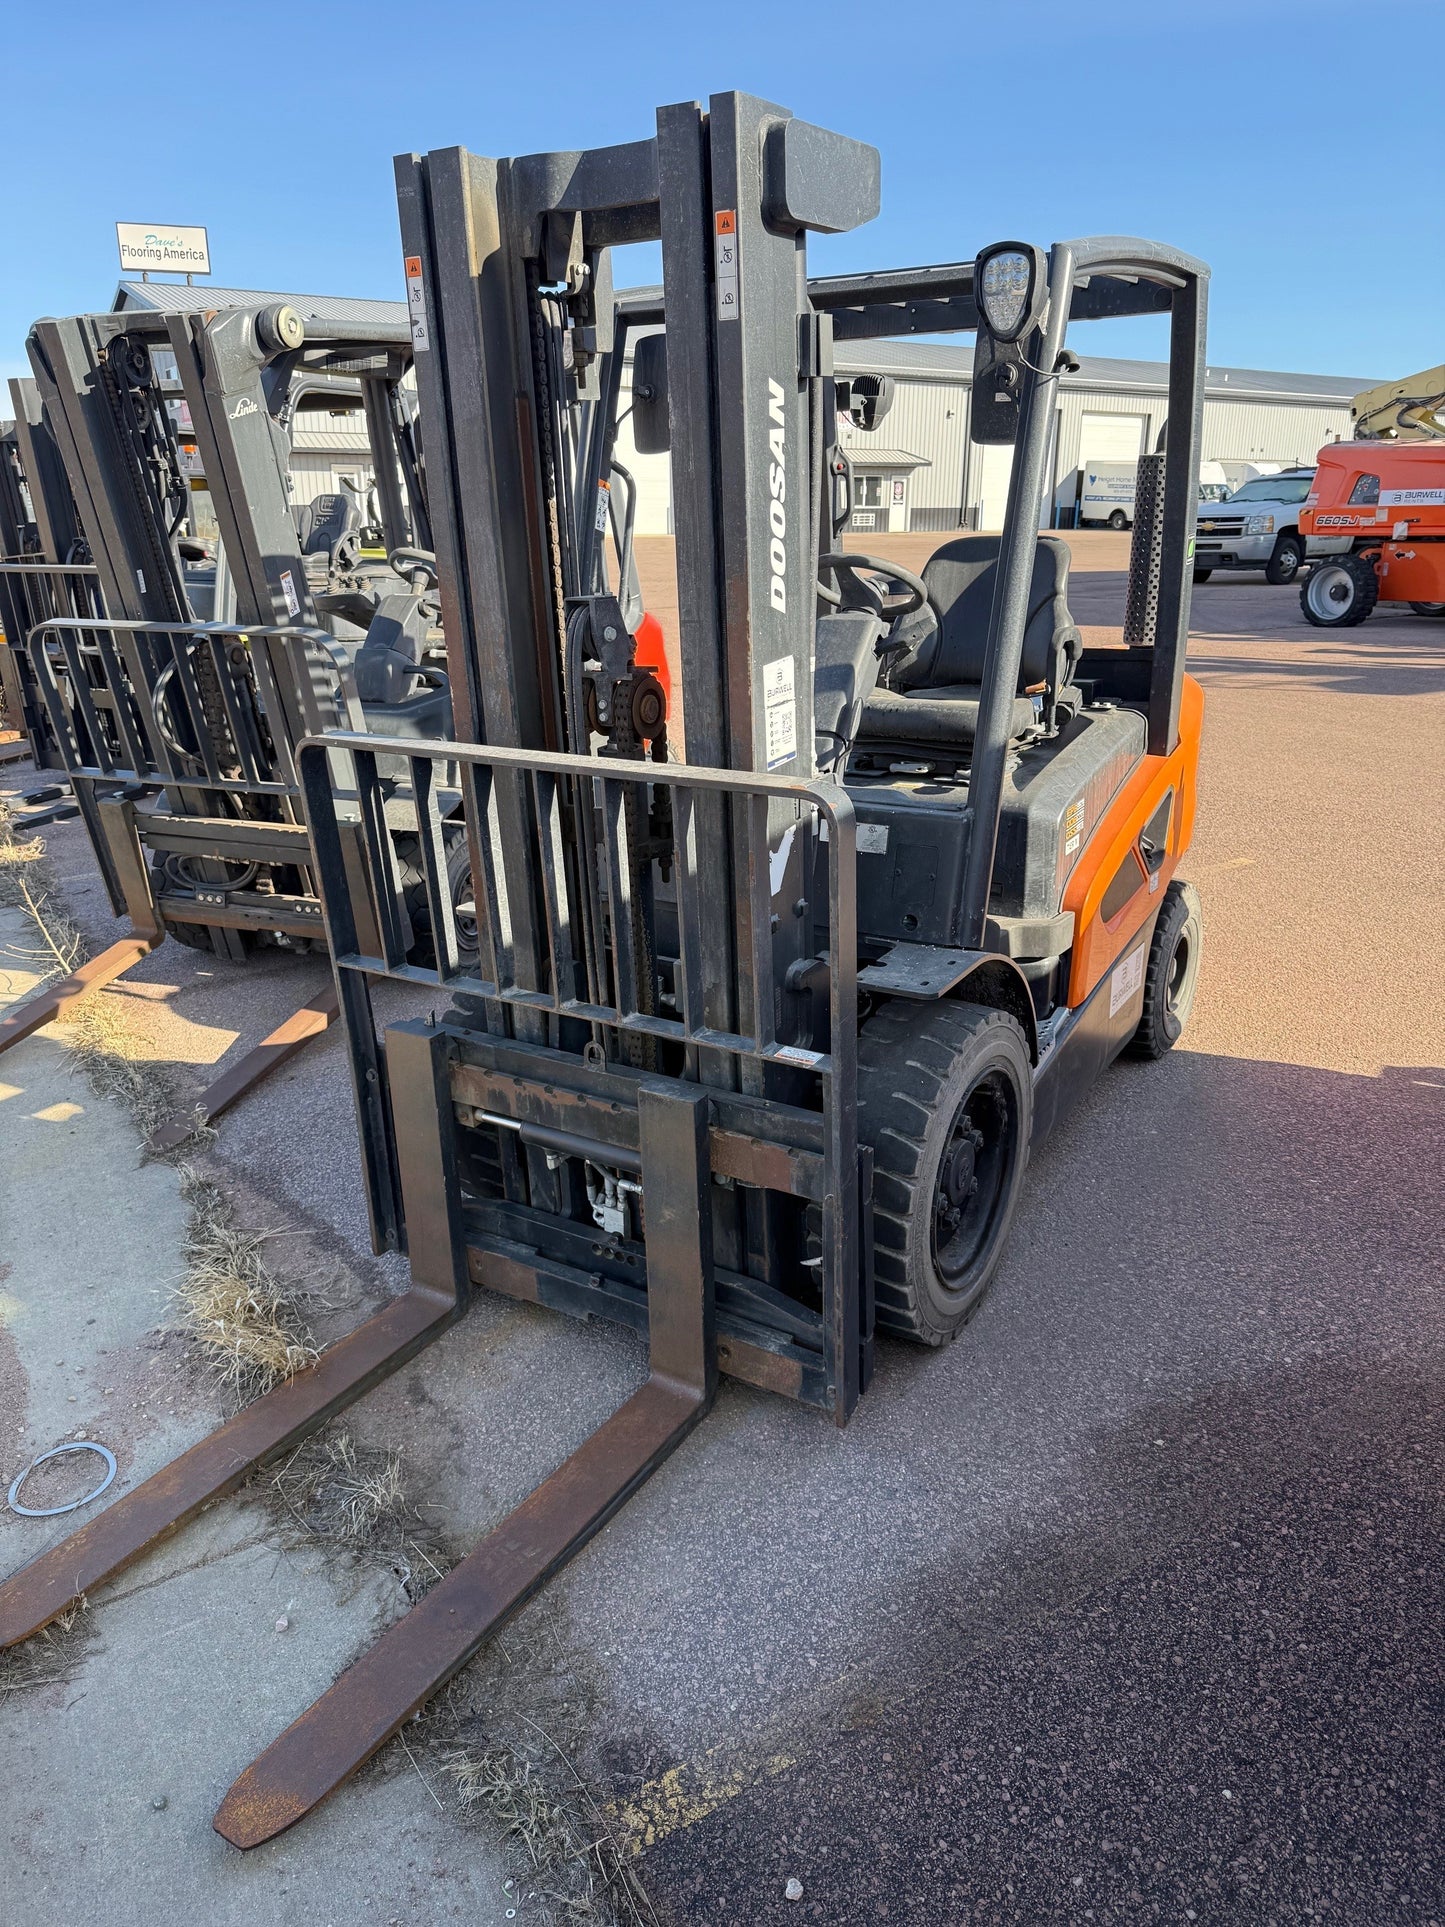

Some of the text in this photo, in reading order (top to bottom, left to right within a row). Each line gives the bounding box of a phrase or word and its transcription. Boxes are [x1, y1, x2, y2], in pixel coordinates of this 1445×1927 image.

[145, 234, 184, 247] Dave's
[122, 244, 205, 261] Flooring America
[229, 397, 258, 420] Linde
[768, 377, 787, 614] DOOSAN
[1404, 490, 1443, 499] BURWELL
[1316, 515, 1359, 525] 660SJ
[767, 683, 793, 699] BURWELL
